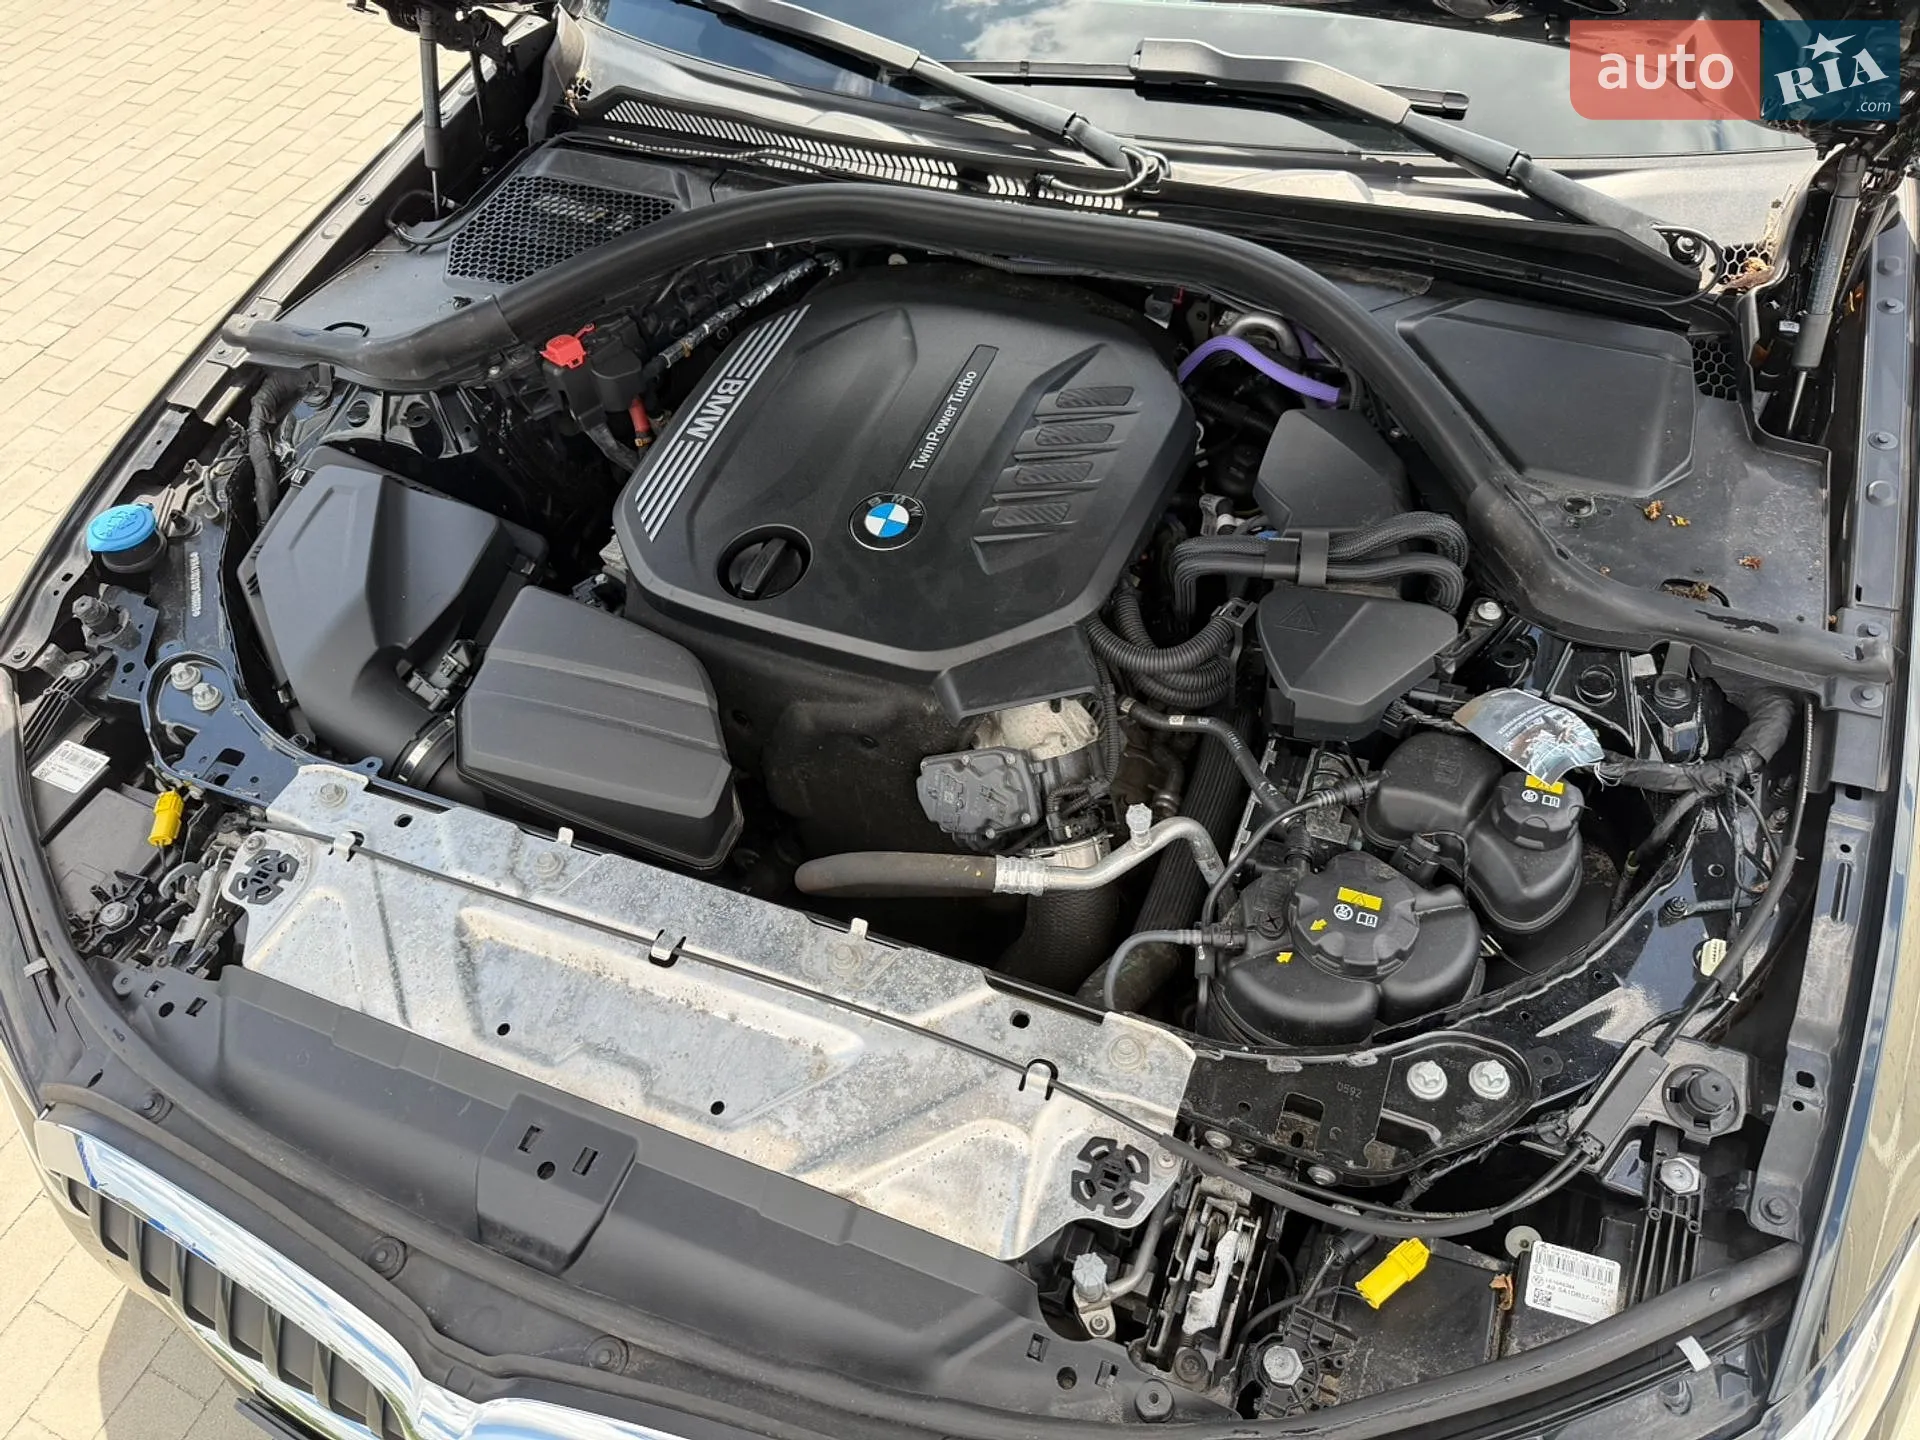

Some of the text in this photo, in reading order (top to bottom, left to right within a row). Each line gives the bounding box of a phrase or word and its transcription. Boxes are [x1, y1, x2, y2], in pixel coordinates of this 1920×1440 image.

[686, 379, 746, 440] BMW
[909, 371, 977, 469] TwinPower Turbo
[867, 494, 923, 517] BMW
